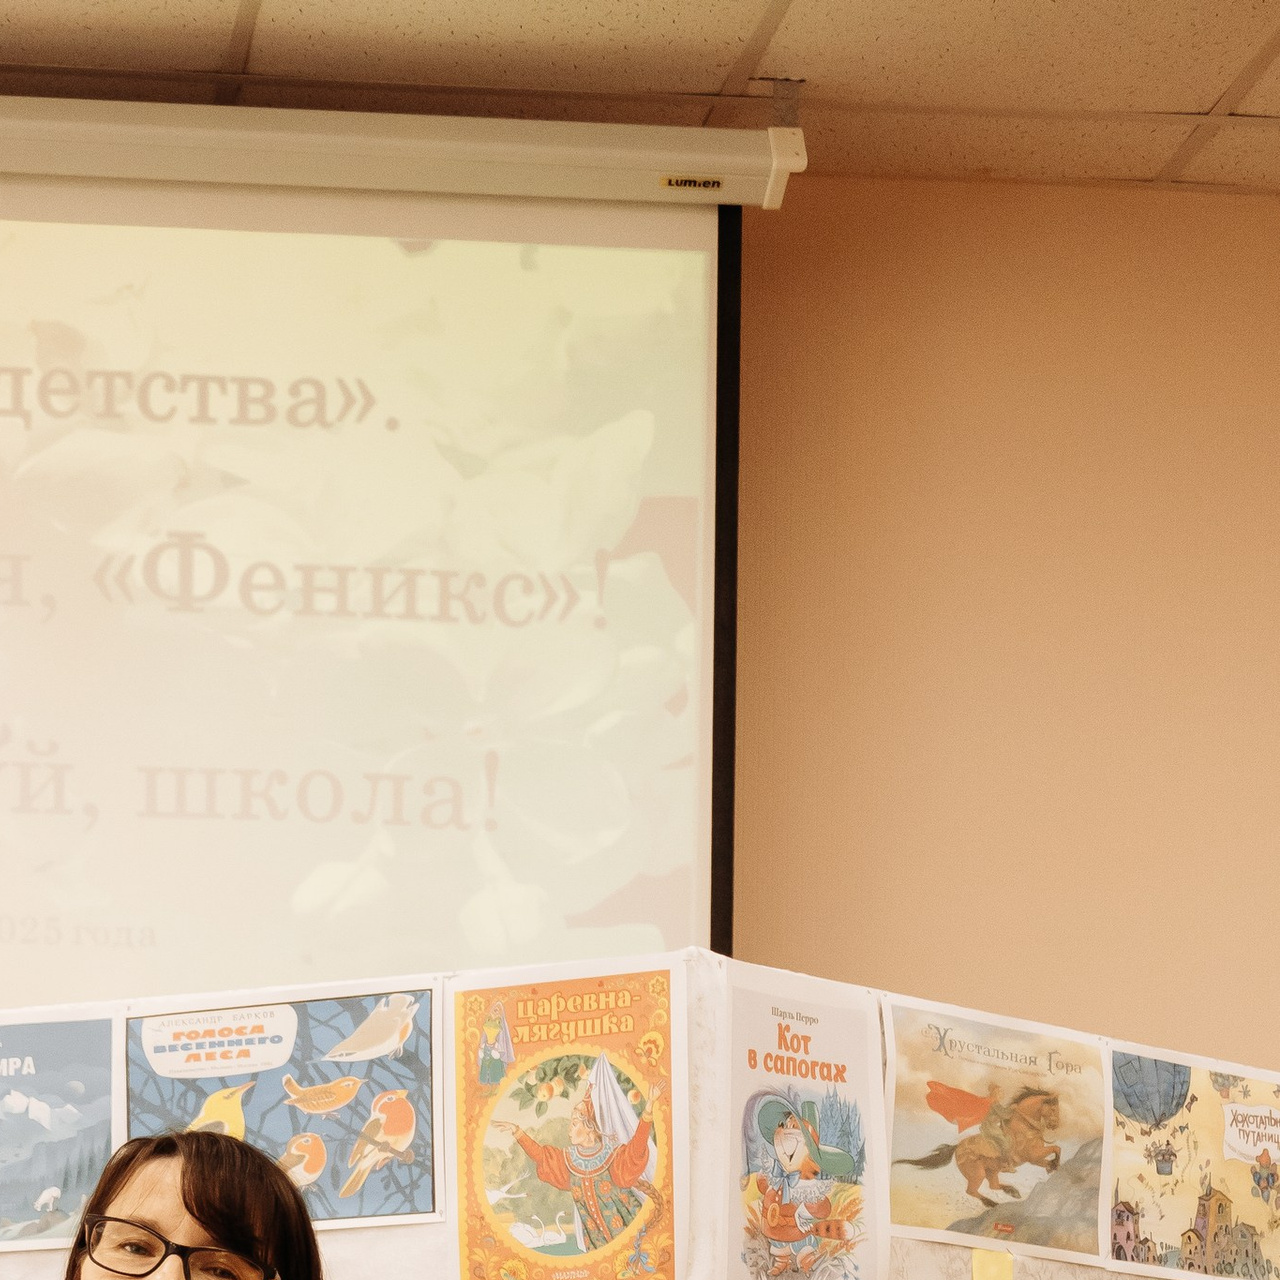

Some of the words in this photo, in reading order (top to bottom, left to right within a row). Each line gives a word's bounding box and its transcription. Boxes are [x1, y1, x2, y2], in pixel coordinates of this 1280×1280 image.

[92, 530, 611, 632] «Феникс»!
[136, 748, 500, 831] школа!
[159, 1015, 224, 1029] АЛЕКСАНДР
[232, 1010, 276, 1022] БАРКОВ
[771, 1006, 795, 1021] Шарль
[795, 1012, 819, 1026] Перро
[153, 1034, 283, 1054] ВЕСЕННЕГО
[172, 1024, 266, 1042] ГОЛОСА
[777, 1022, 812, 1056] Кот
[184, 1048, 252, 1064] ЛЕСА
[926, 1023, 1038, 1067] Хрустальная
[1047, 1050, 1083, 1076] Гора
[763, 1052, 847, 1084] сапогах
